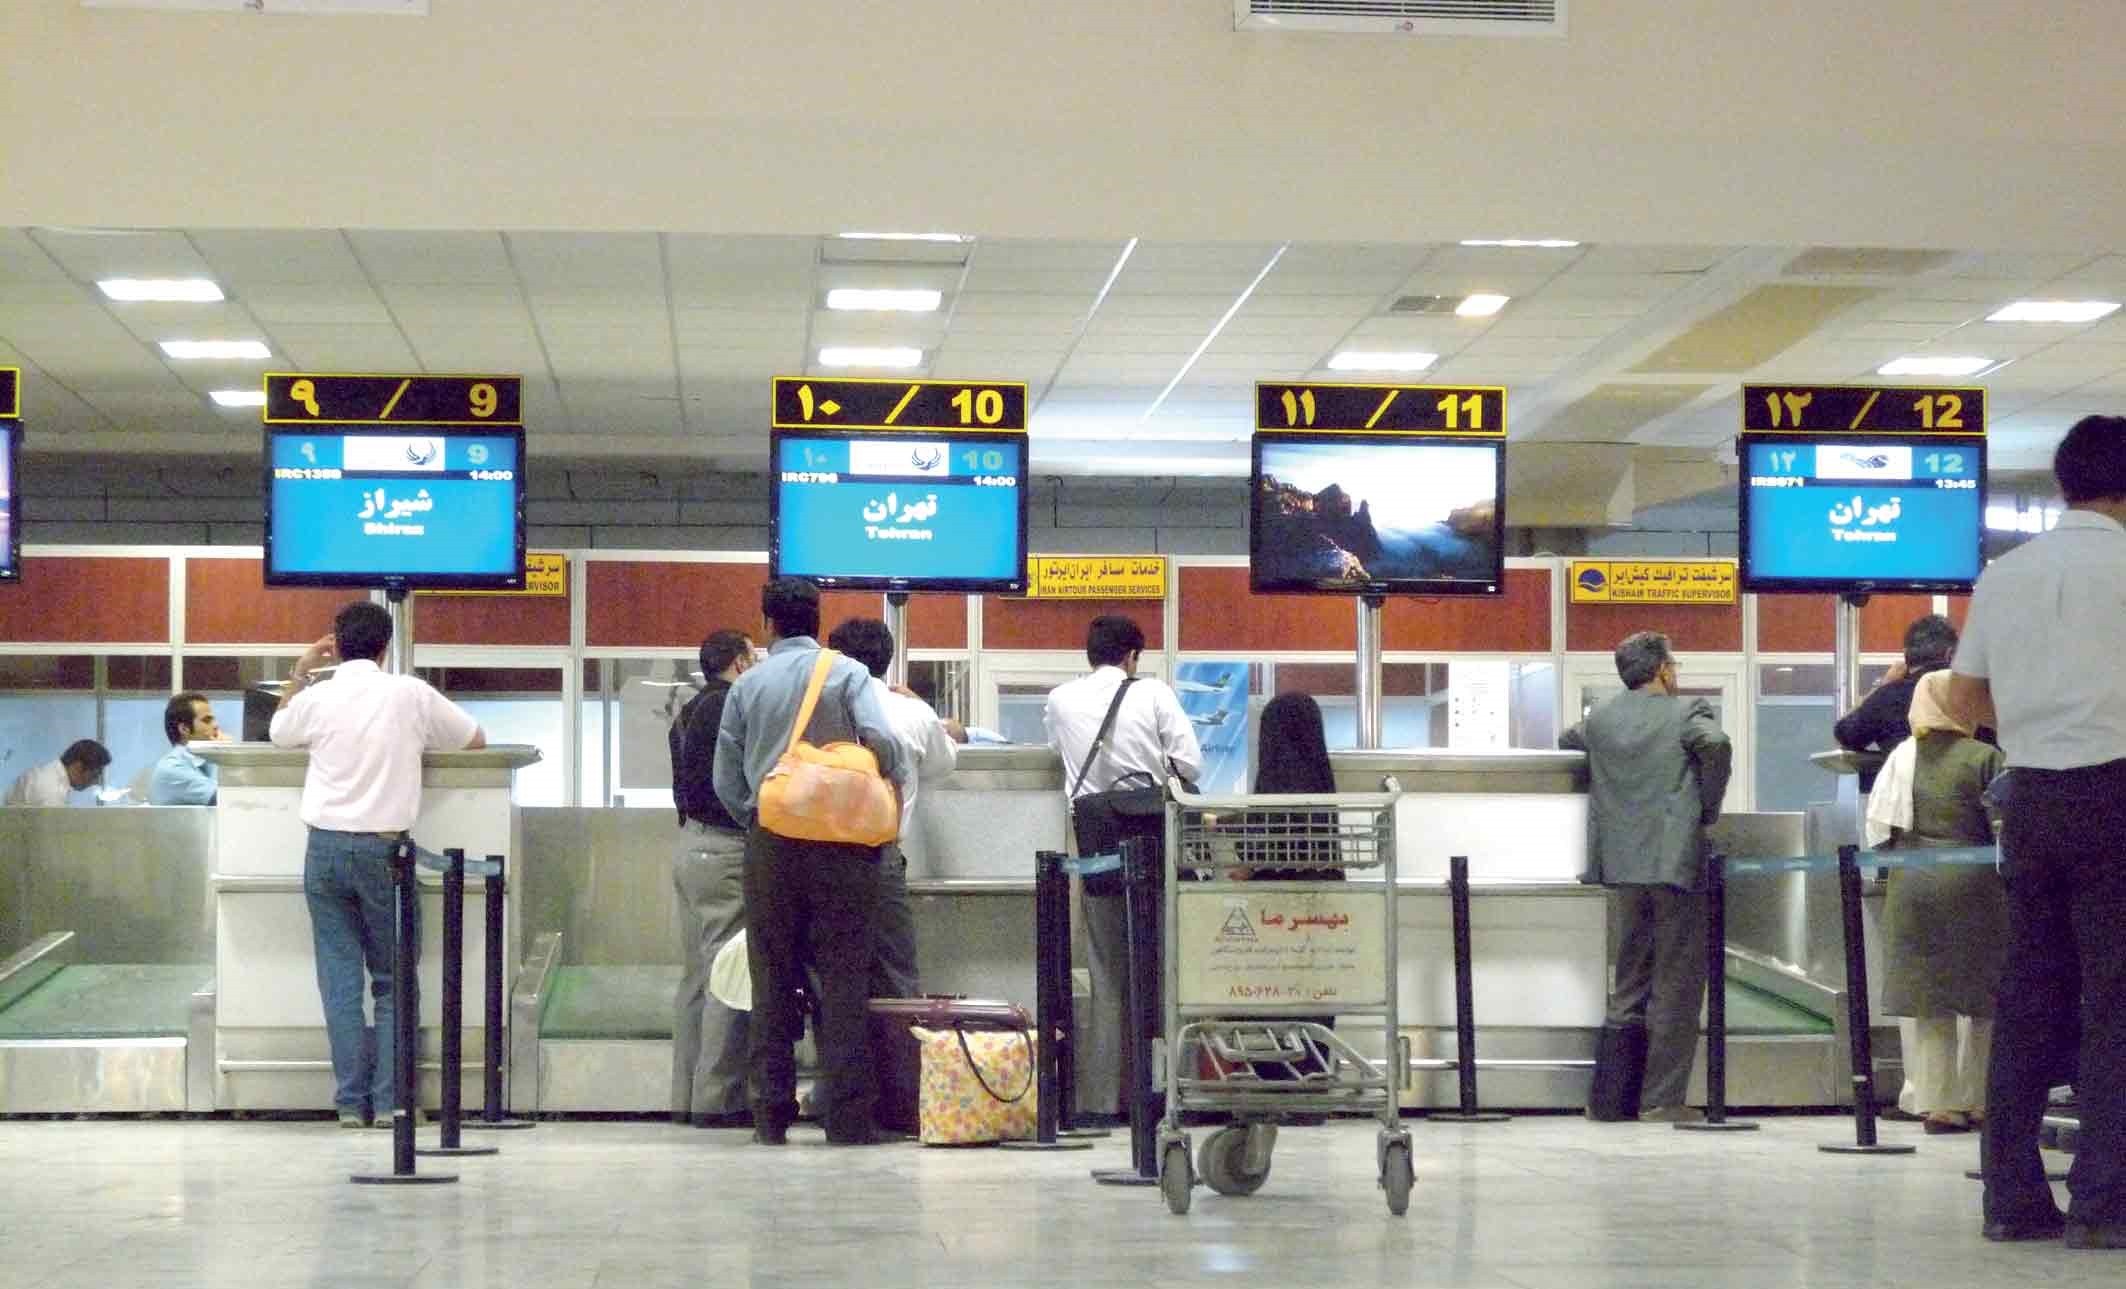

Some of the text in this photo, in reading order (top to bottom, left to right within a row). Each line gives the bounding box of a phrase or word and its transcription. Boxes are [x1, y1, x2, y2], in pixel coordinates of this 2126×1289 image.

[290, 379, 320, 416] ۹
[469, 383, 497, 417] 9
[797, 384, 841, 421] ۱۰
[951, 389, 1004, 424] 10
[1281, 389, 1316, 426] ۱۱
[1437, 394, 1483, 429] 11
[1765, 391, 1812, 427] ۱۲
[1913, 394, 1963, 428] 12
[466, 444, 489, 464] 9
[962, 450, 1003, 470] 10
[1924, 453, 1964, 473] 12
[469, 470, 513, 481] 14:00
[973, 476, 1016, 487] 14:00
[1935, 479, 1977, 489] 13:45
[357, 488, 433, 519] شیراز
[863, 492, 938, 523] تهران
[1828, 496, 1902, 526] تهران
[1647, 589, 1680, 599] TRAFFIC
[1682, 589, 1731, 599] SUPERVISOR
